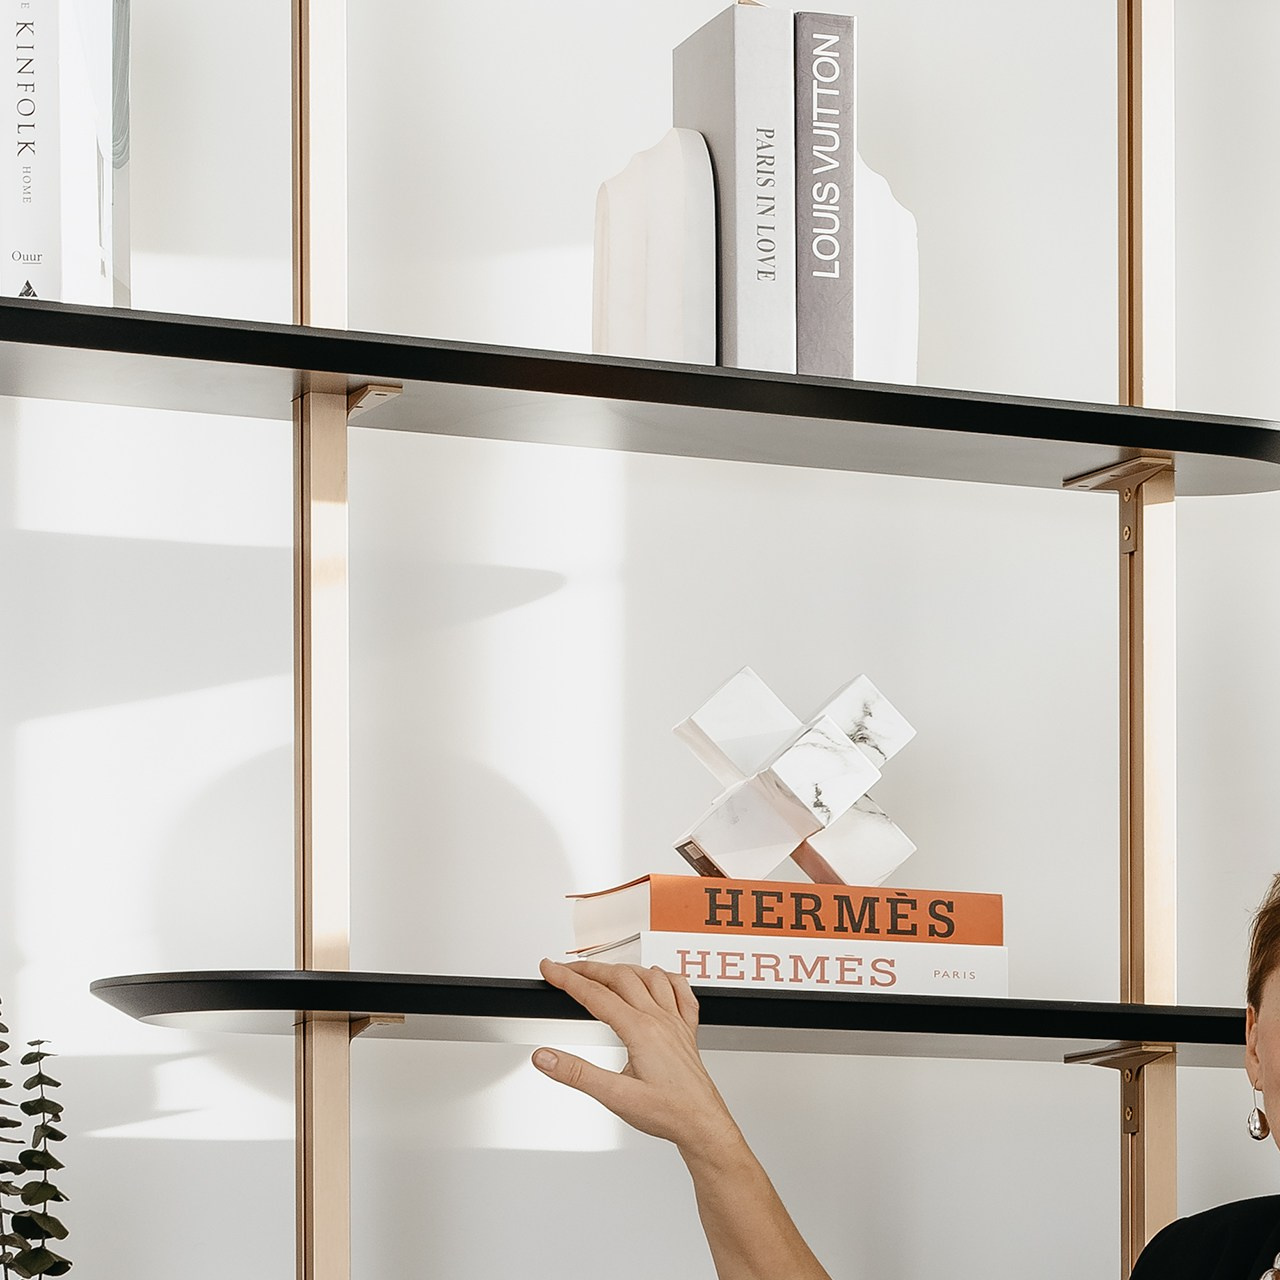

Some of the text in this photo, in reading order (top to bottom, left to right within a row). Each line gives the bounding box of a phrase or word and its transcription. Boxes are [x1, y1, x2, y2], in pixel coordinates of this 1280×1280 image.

[15, 20, 36, 157] KINFOLK
[812, 32, 841, 279] LOUIS VUITTON
[22, 166, 32, 204] HOME
[756, 127, 776, 282] PARIS IN LOVE
[11, 250, 43, 262] Ouur
[704, 887, 956, 939] HERMÈS
[934, 969, 977, 981] PARIS
